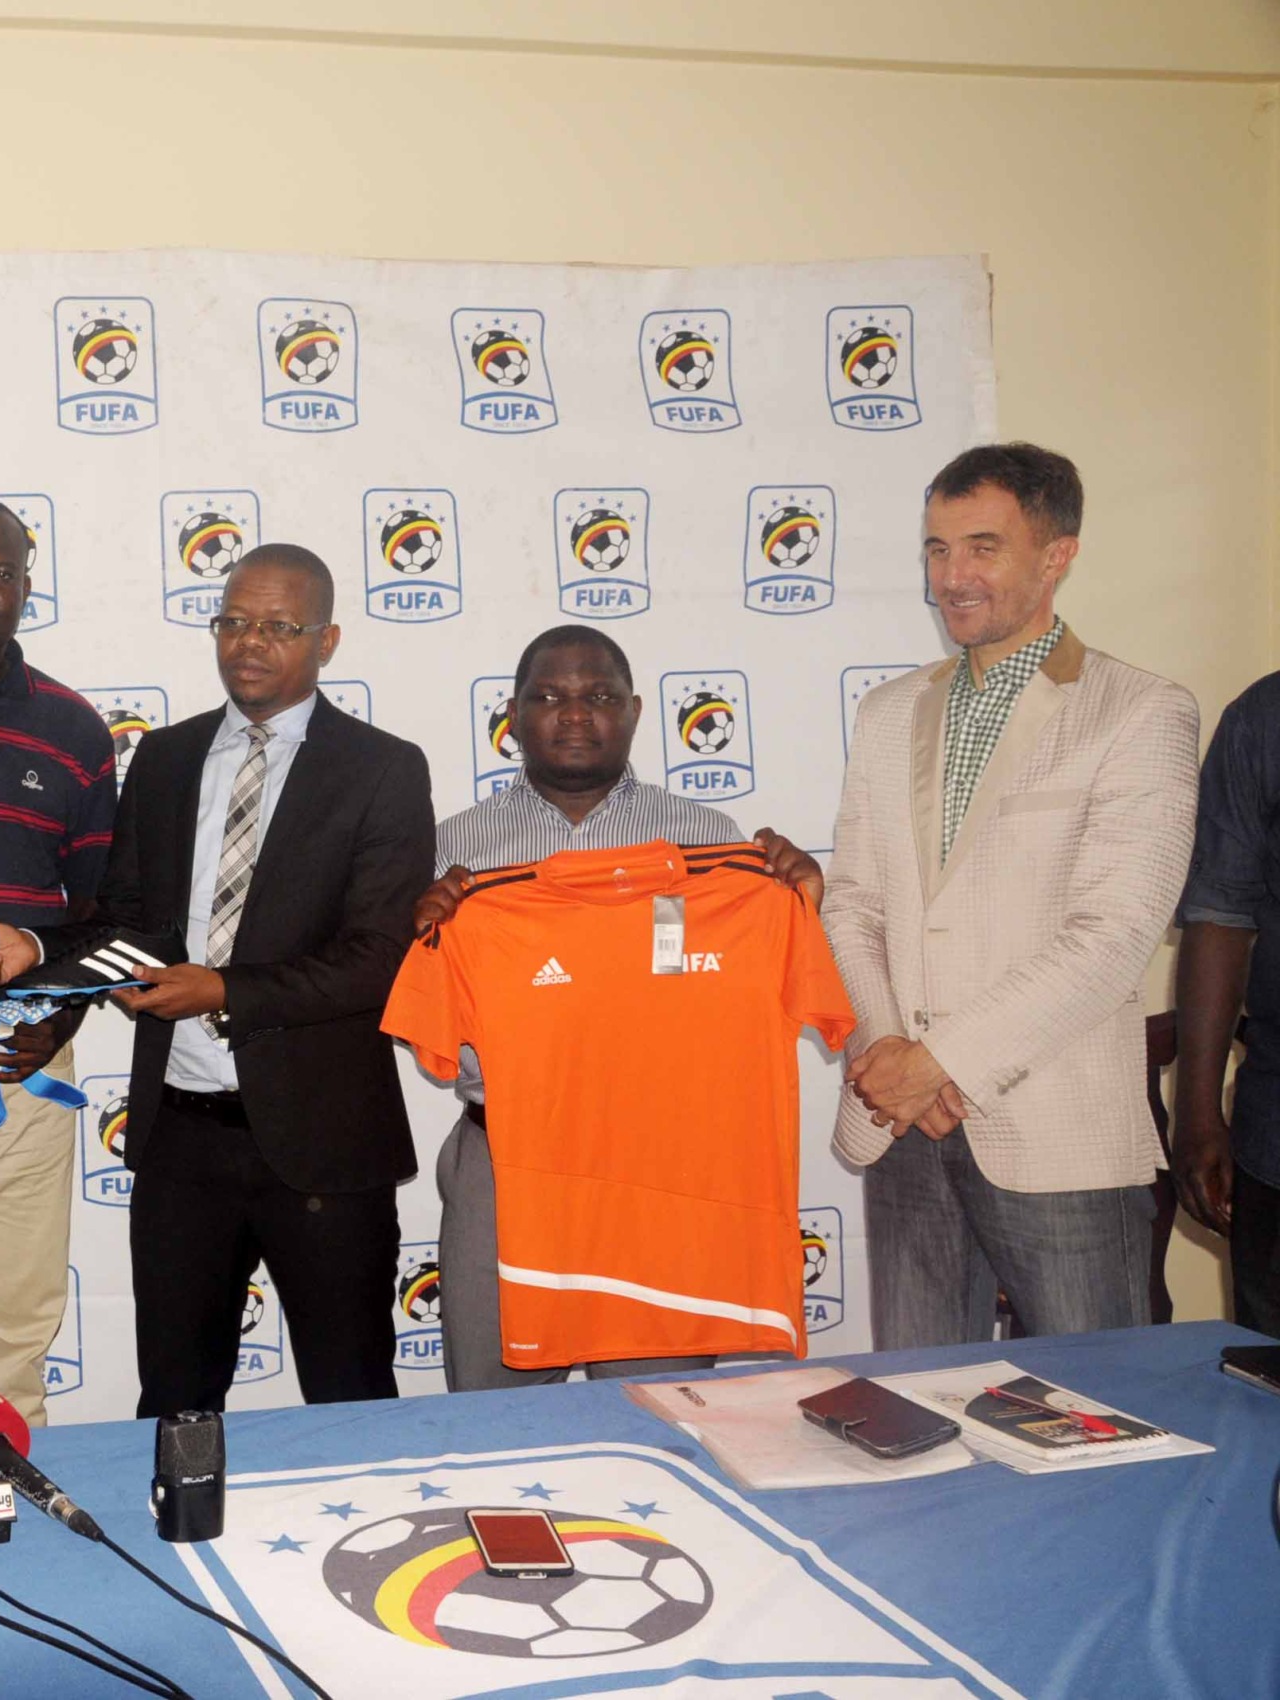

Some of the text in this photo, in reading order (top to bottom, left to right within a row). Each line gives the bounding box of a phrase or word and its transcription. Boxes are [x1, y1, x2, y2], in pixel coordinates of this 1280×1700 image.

[75, 402, 139, 422] FUFA
[280, 402, 340, 420] FUFA
[479, 403, 540, 421] FUFA
[665, 405, 723, 422] FUFA
[846, 405, 905, 421] FUFA
[383, 592, 443, 610] FUFA
[575, 589, 632, 606] FUFA
[760, 585, 816, 602] FUFA
[680, 769, 737, 789] FUFA
[682, 953, 721, 972] IFA
[532, 974, 572, 986] adidas
[400, 1338, 443, 1356] FUF
